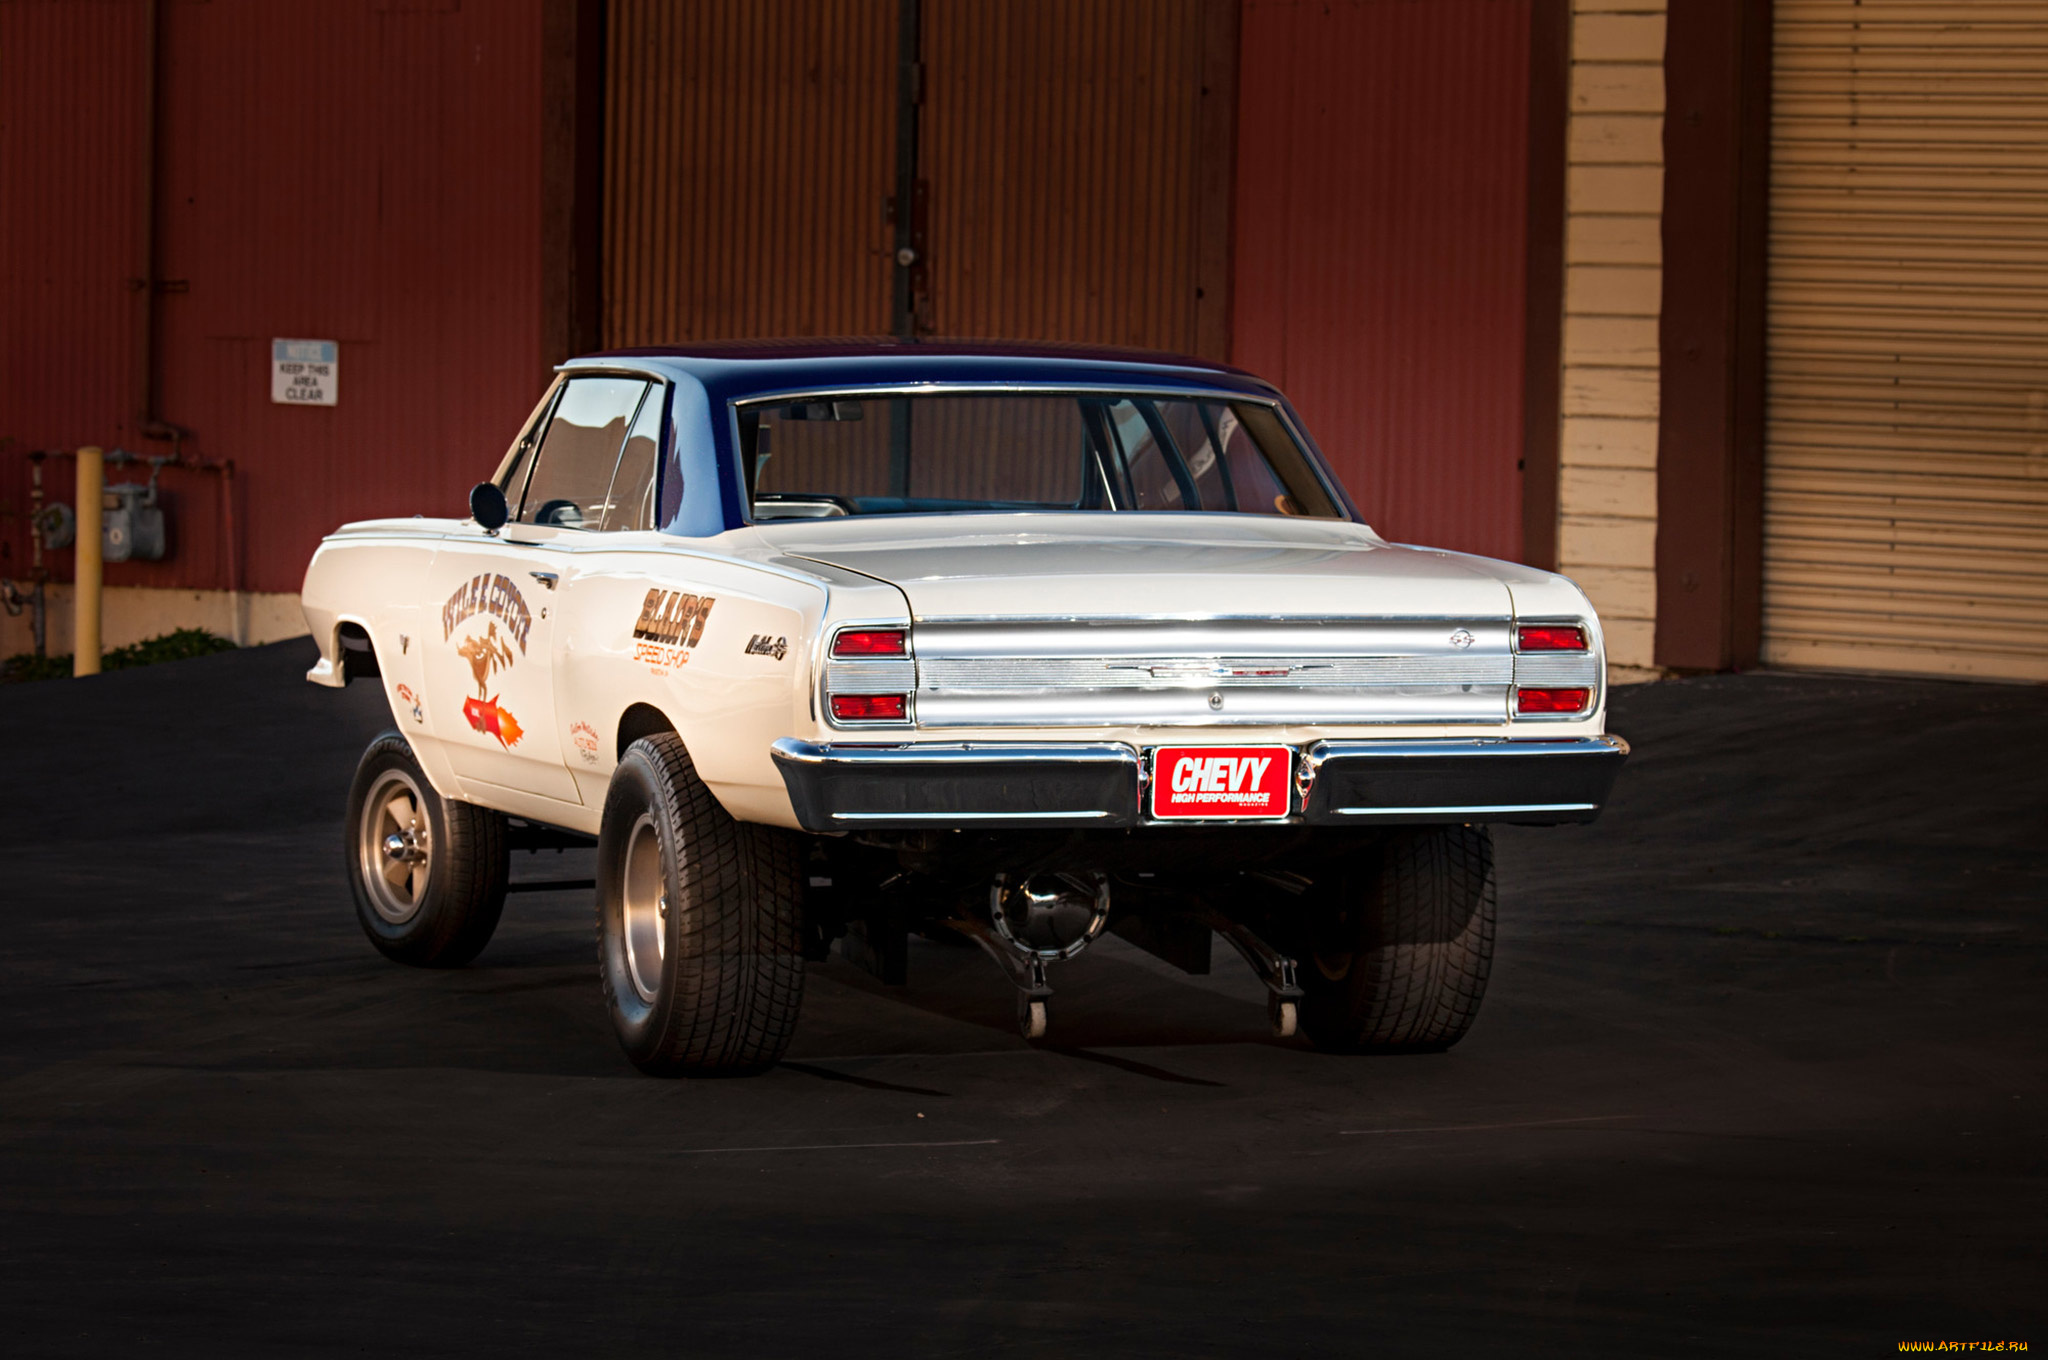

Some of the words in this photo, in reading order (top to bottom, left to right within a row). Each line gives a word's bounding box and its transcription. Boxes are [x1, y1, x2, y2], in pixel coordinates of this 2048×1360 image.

[280, 363, 304, 375] KEEP
[308, 364, 329, 376] THIS
[293, 376, 318, 386] AREA
[285, 387, 323, 401] CLEAR
[633, 643, 664, 665] SPEED
[663, 649, 689, 669] SHOP
[1171, 757, 1272, 793] CHEVY
[1171, 793, 1196, 803] HIGH
[1195, 792, 1271, 803] PERFORMANCE
